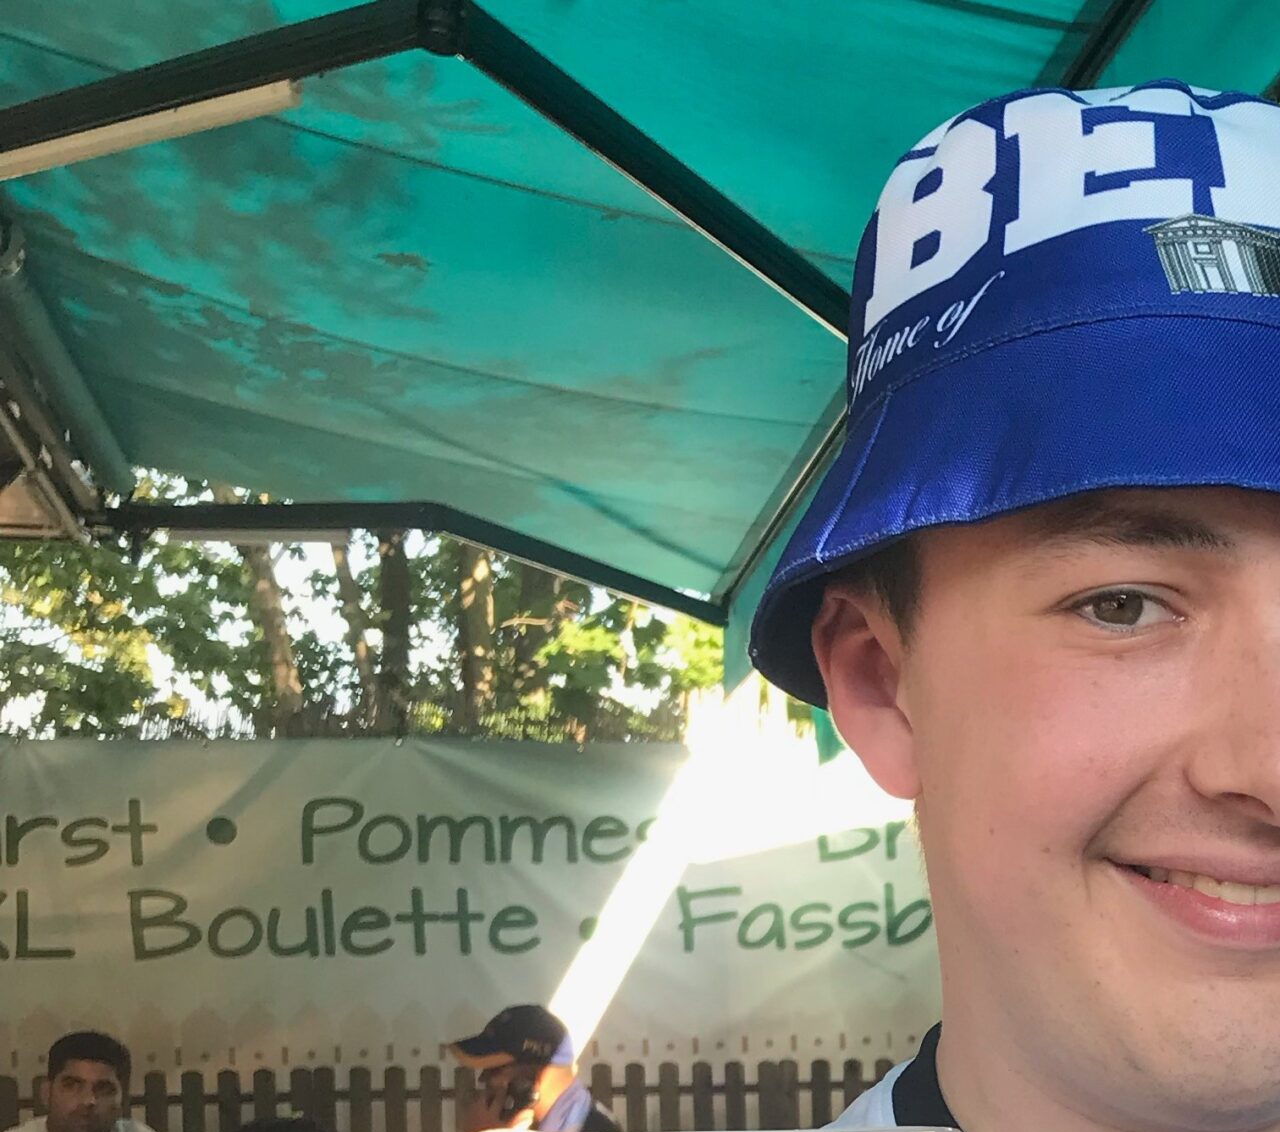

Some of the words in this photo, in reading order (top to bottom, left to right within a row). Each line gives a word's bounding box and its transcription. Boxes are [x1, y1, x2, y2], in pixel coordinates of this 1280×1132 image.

[849, 319, 930, 414] Home
[934, 271, 1006, 348] of
[0, 798, 158, 866] rst
[0, 888, 75, 959] L
[128, 887, 541, 958] Boulette
